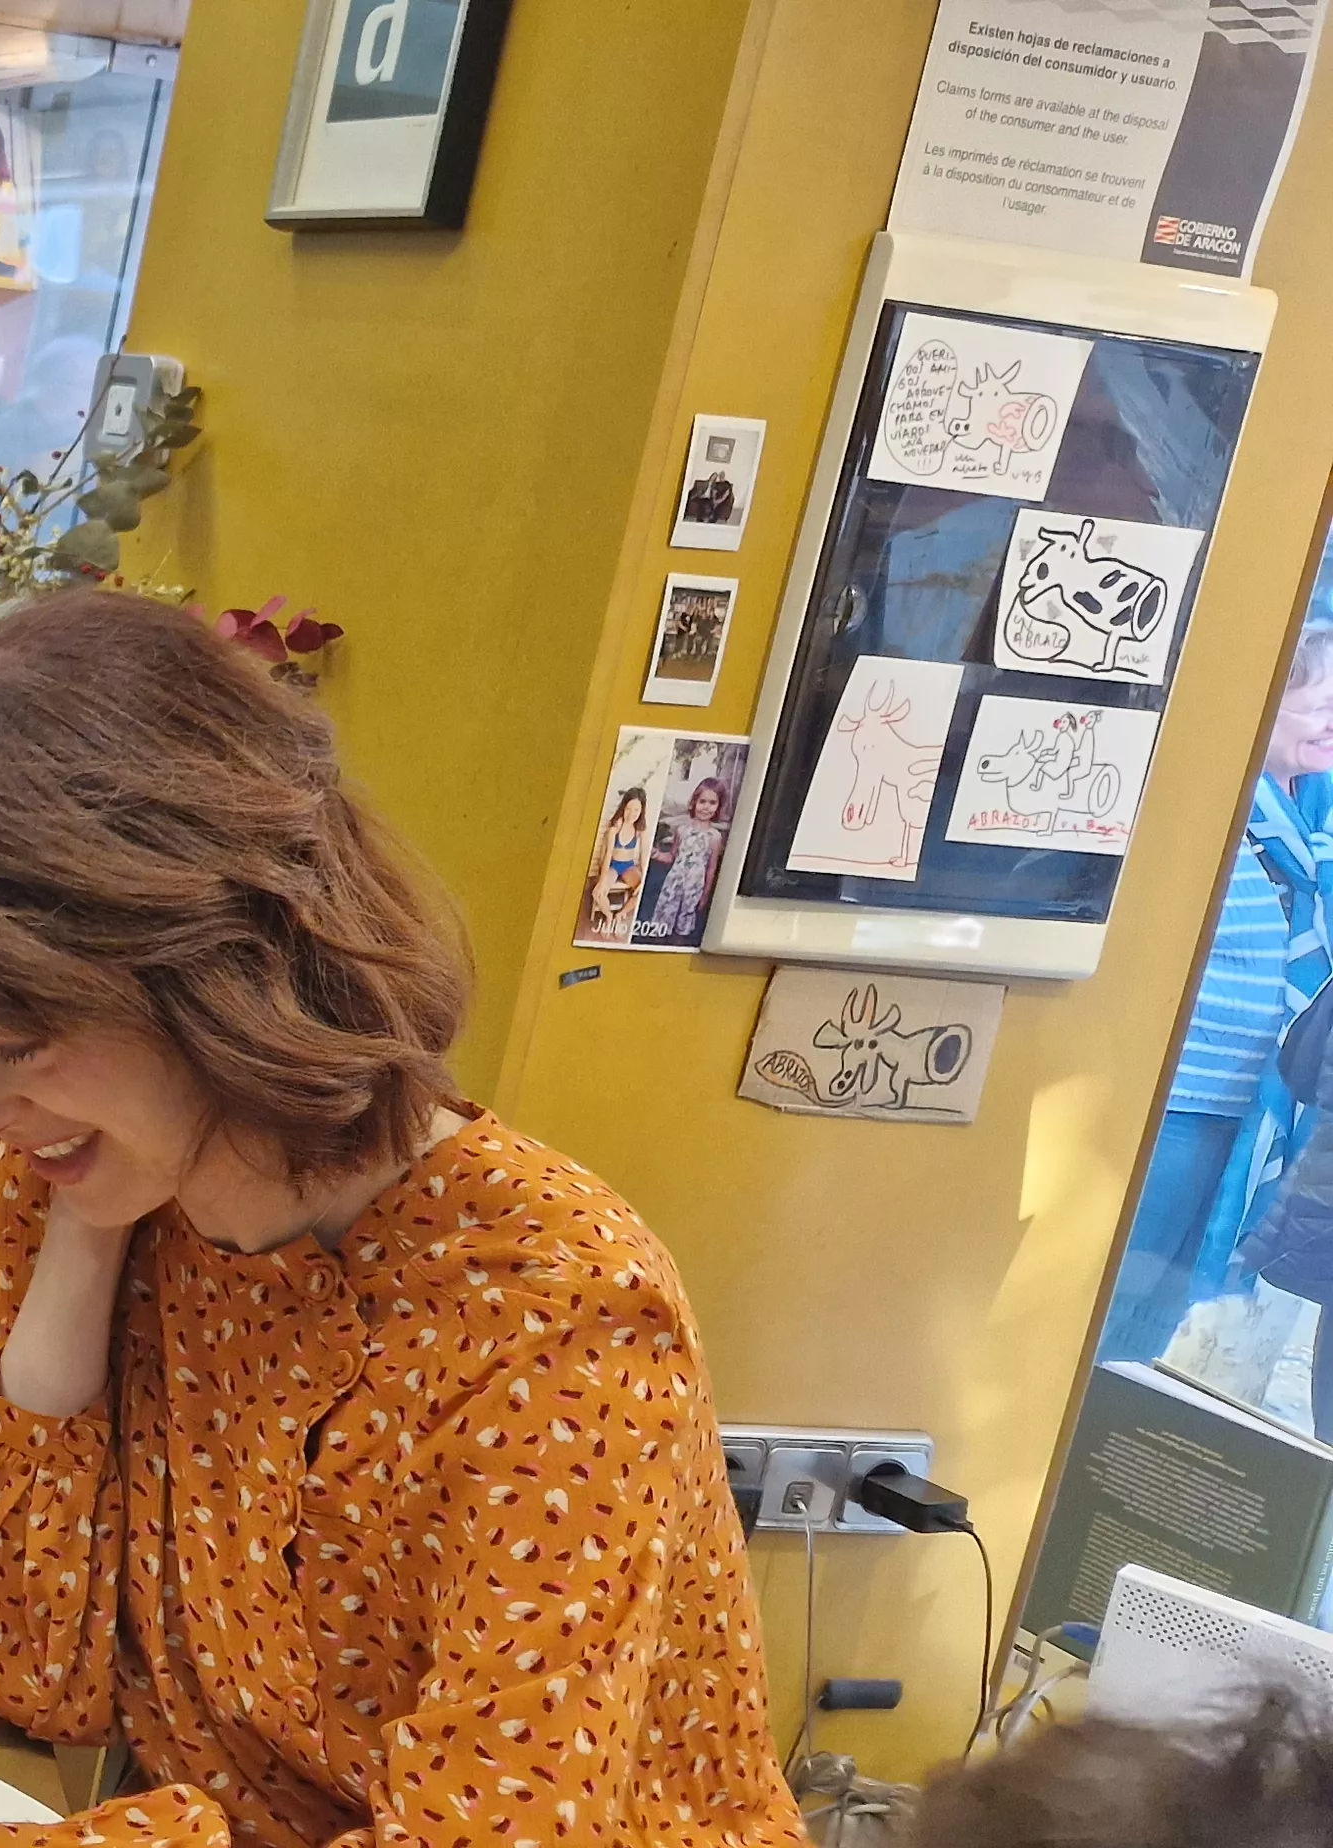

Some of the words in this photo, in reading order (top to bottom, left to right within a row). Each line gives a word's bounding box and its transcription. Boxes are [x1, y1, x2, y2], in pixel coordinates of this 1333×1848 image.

[968, 21, 1014, 41] Existen
[1017, 28, 1051, 49] hojas
[1054, 36, 1070, 52] de
[1072, 41, 1161, 68] reclamaciones
[1162, 58, 1171, 68] a
[948, 40, 1020, 65] disposición
[1023, 52, 1042, 67] del
[1045, 57, 1118, 81] consumidor
[1120, 72, 1129, 85] y
[1131, 74, 1178, 92] usuario.
[936, 80, 977, 99] Claims
[979, 87, 1012, 106] forms
[1014, 97, 1034, 109] are
[1036, 97, 1086, 118] available
[1088, 107, 1101, 120] at
[1102, 109, 1121, 124] the
[1123, 113, 1170, 132] disposal
[965, 107, 978, 120] of
[980, 109, 998, 124] the
[1000, 114, 1056, 134] consumer
[1058, 122, 1080, 138] and
[1082, 127, 1100, 142] the
[924, 142, 945, 157] Les
[948, 147, 999, 168] imprimés
[1001, 155, 1016, 169] de
[1018, 157, 1082, 181] réclamation
[1085, 171, 1098, 183] se
[1101, 172, 1146, 190] trouvent
[933, 164, 943, 178] la
[945, 166, 1006, 187] disposition
[1008, 177, 1022, 191] du
[1024, 181, 1106, 205] consommateur
[1107, 192, 1118, 205] et
[1120, 194, 1136, 209] de
[1175, 233, 1191, 247] DE
[1179, 220, 1237, 240] GOBIERNO
[895, 413, 924, 425] PARA
[1013, 632, 1068, 649] ABRAZO
[967, 809, 1040, 831] ABRAZOS
[591, 918, 628, 936] Julio
[632, 920, 668, 937] 2020
